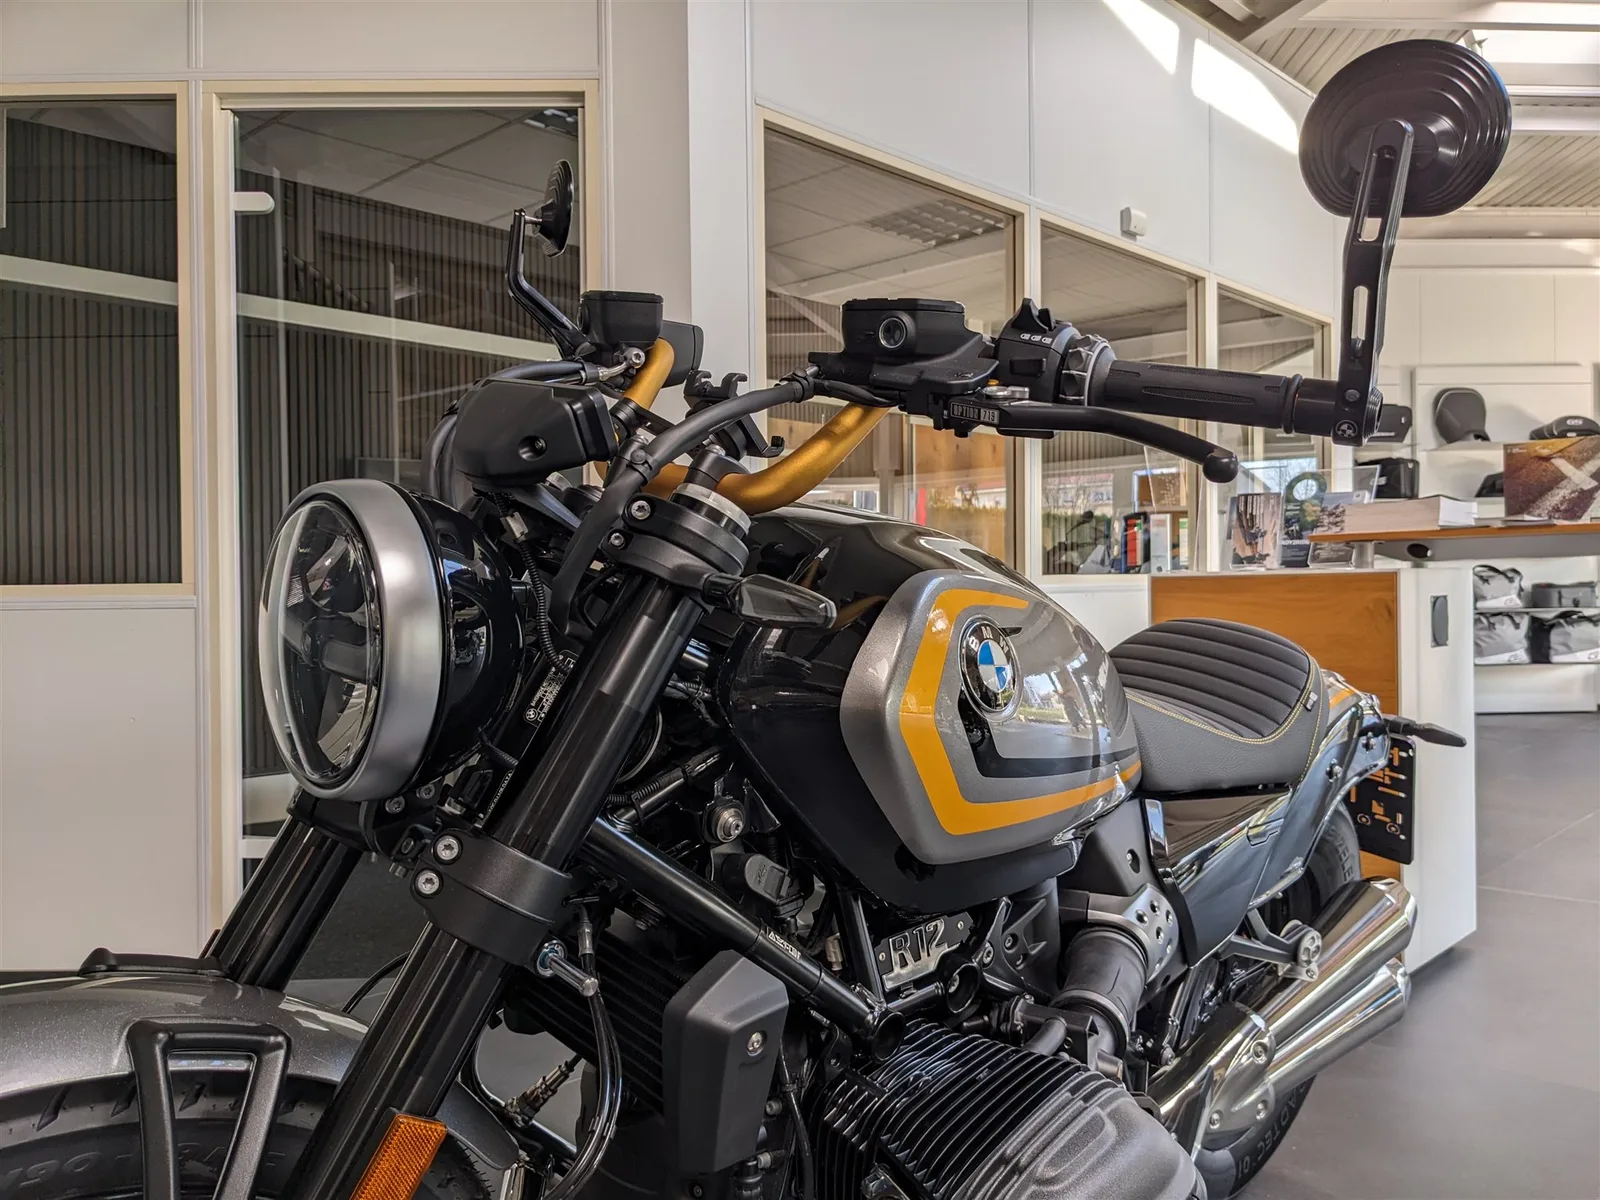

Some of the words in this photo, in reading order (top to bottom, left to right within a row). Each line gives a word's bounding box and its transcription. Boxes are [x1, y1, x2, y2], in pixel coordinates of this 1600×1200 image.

[953, 403, 979, 420] OPTION
[982, 410, 996, 422] 719
[969, 625, 1010, 654] BMW
